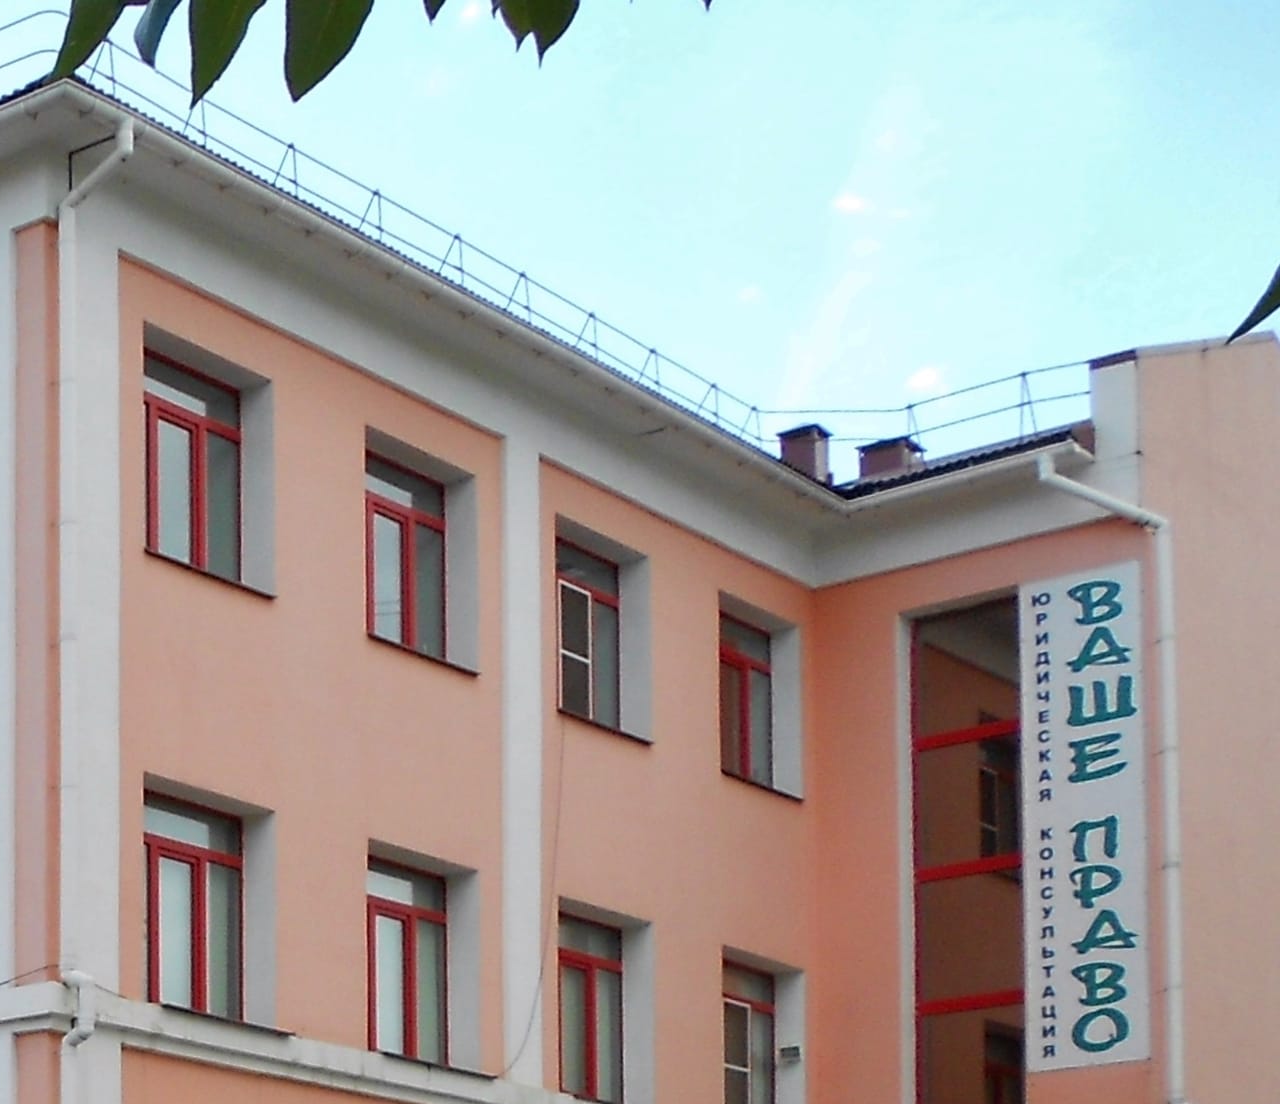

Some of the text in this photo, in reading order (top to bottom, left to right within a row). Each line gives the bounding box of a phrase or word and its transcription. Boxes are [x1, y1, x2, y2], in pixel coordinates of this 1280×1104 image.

[1031, 593, 1057, 1059] ЮРИДИЧЕСКАЯ КОНСУЛЬТАЦИЯ
[1066, 580, 1139, 1053] ВАШЕ ПРАВО
